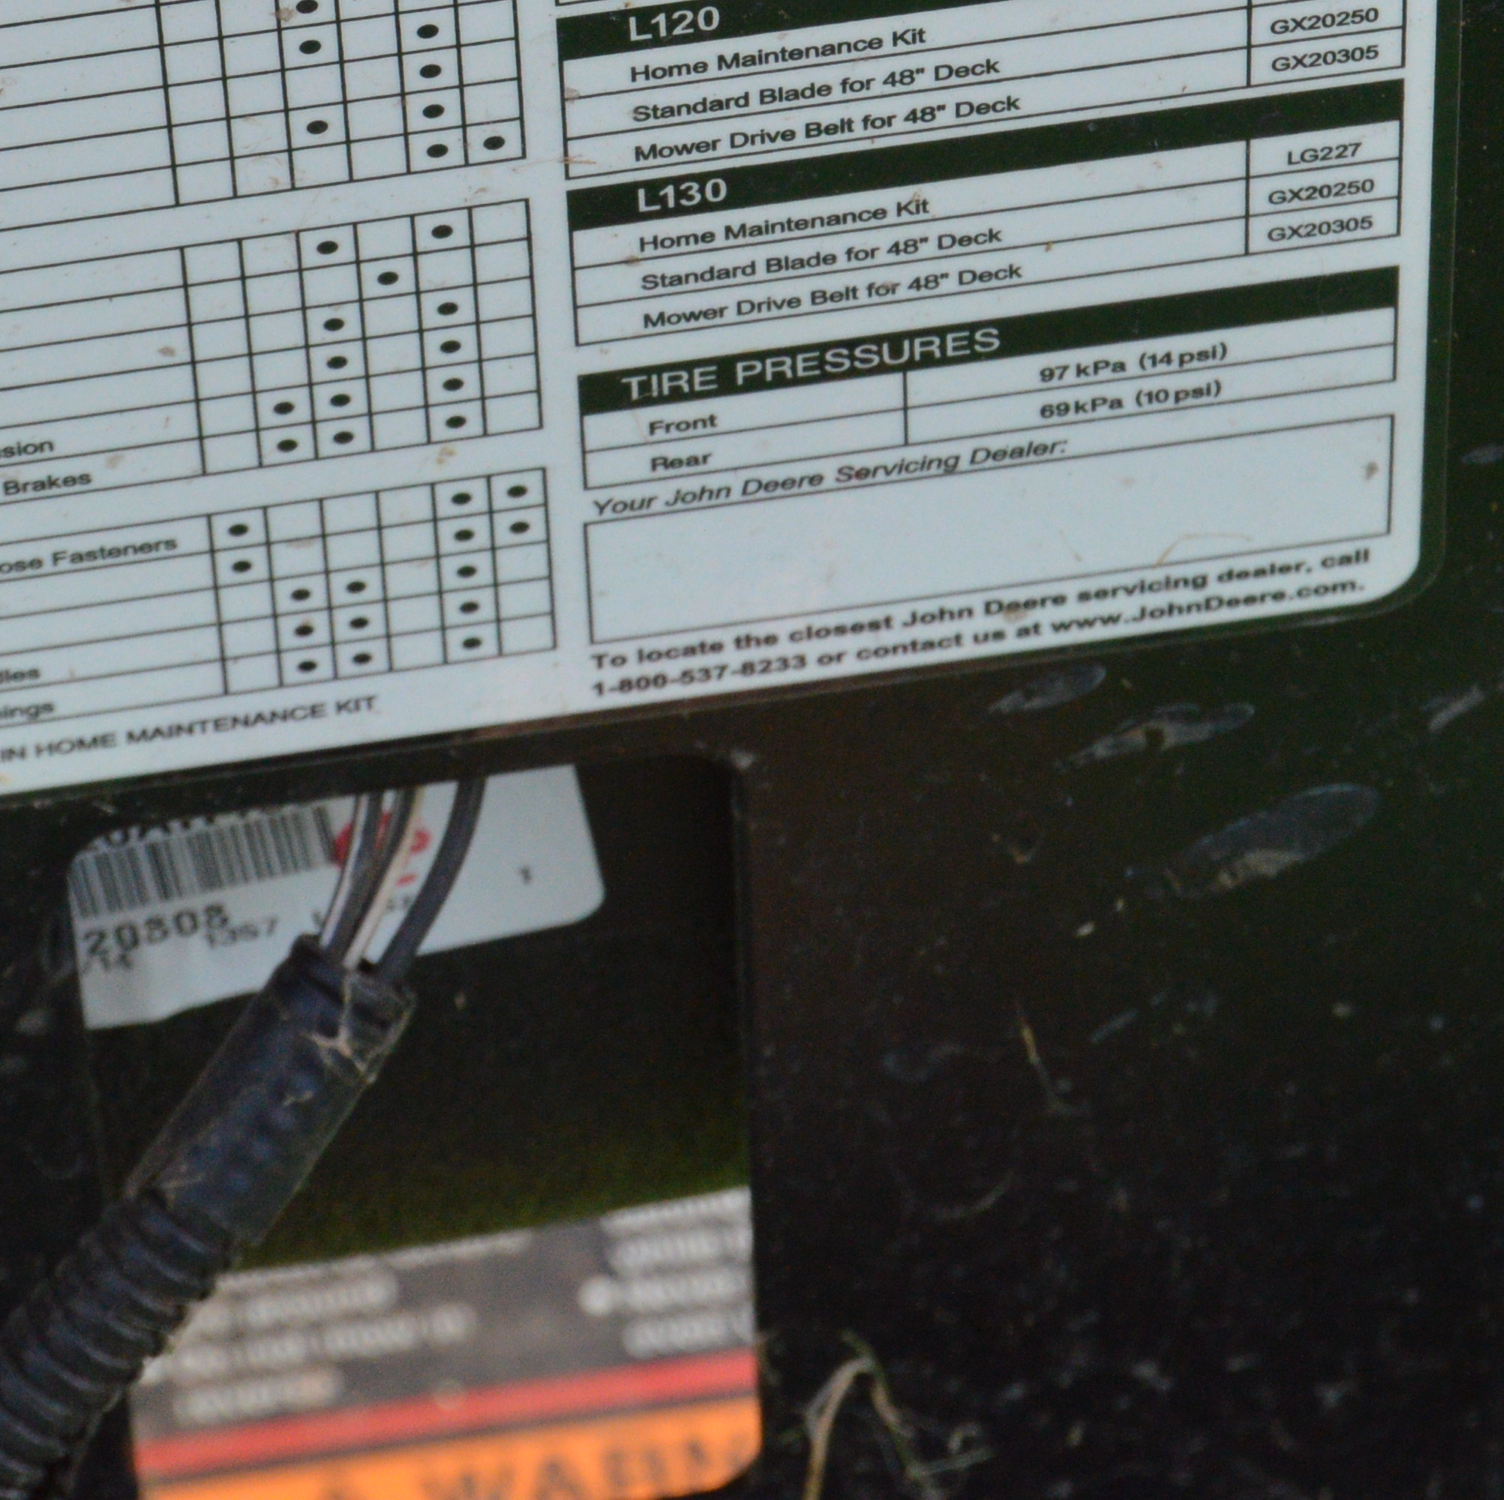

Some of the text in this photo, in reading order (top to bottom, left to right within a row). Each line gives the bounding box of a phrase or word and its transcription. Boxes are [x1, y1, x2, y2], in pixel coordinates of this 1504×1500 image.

[628, 5, 720, 42] L120
[1268, 6, 1379, 35] GX20250
[629, 27, 926, 83] Home Maintenance Kit
[1270, 43, 1380, 72] GX20305
[631, 90, 750, 123] Standard
[758, 81, 833, 106] Blade
[838, 76, 876, 94] for
[933, 57, 1000, 82] Deck
[1286, 141, 1362, 166] LG227
[636, 177, 727, 212] L130
[1267, 177, 1375, 205] GX20250
[638, 198, 930, 253] Home Maintenance Kit
[1266, 214, 1373, 242] GX20305
[620, 327, 1000, 401] TIRE PRESSURES
[647, 413, 717, 436] Front
[649, 452, 711, 472] Rear
[593, 495, 657, 516] Your
[663, 484, 732, 507] John
[740, 472, 825, 497] Deere
[834, 454, 961, 483] Servicing
[50, 538, 178, 567] Fasteners
